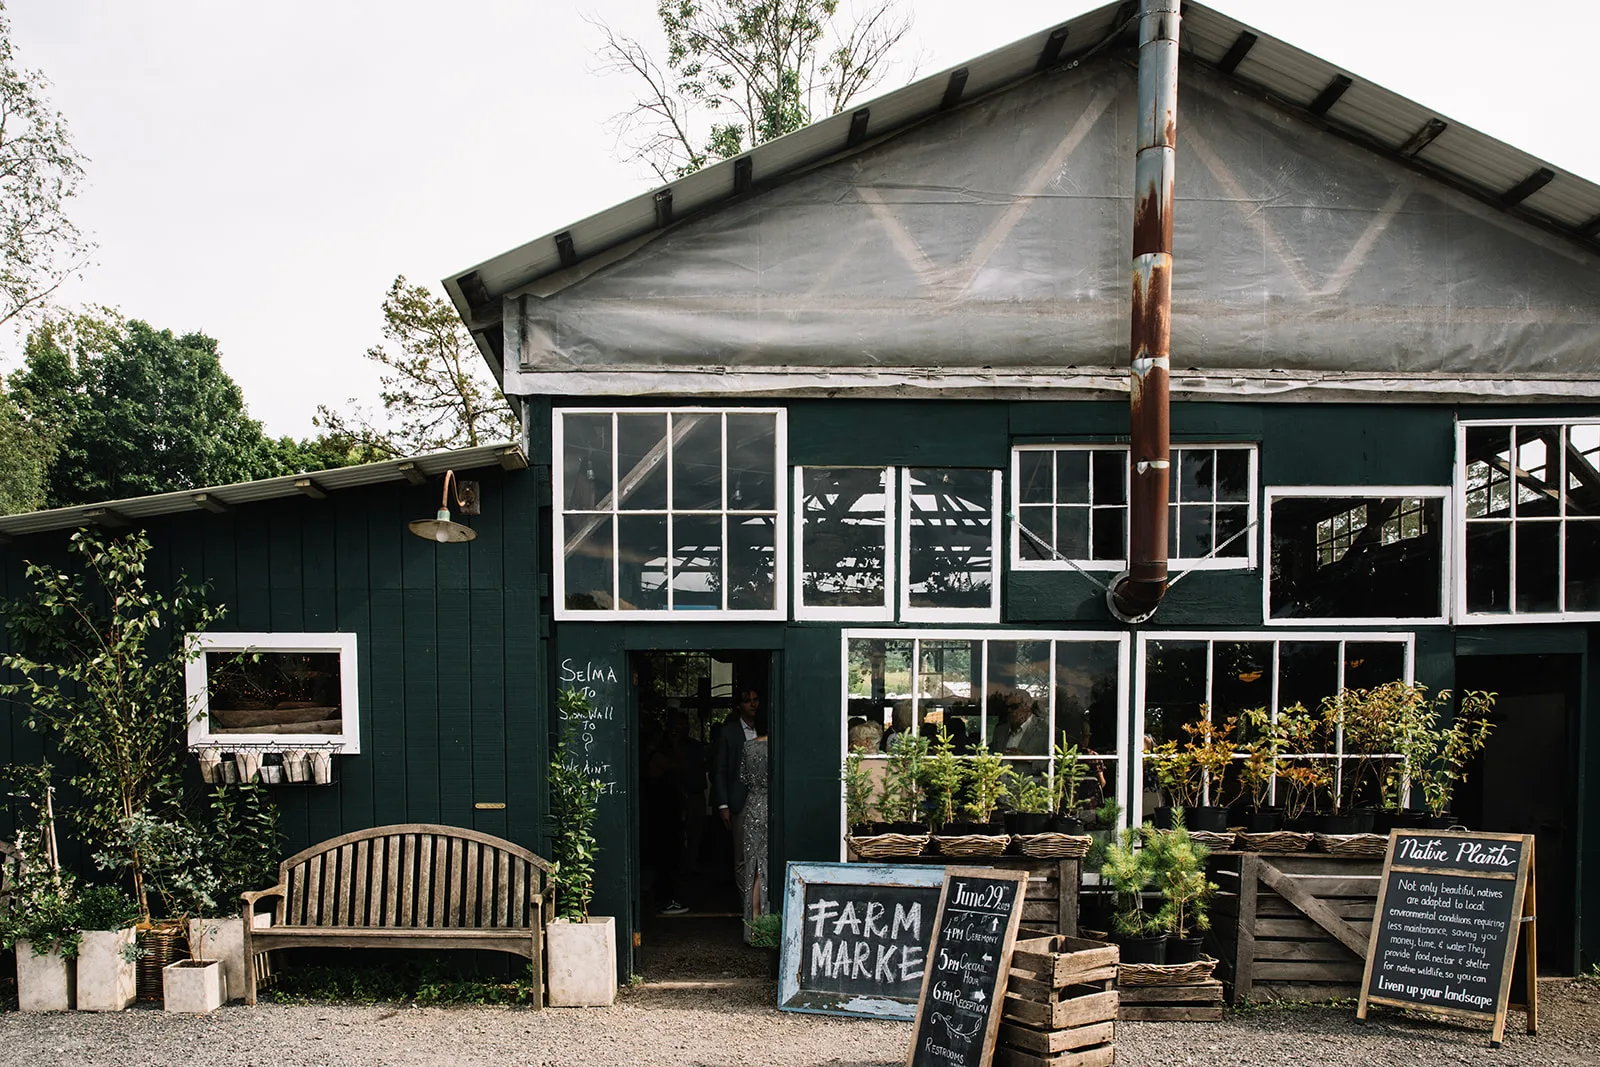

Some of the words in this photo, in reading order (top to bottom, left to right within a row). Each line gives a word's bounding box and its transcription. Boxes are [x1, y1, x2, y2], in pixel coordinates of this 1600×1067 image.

[582, 720, 596, 730] TO
[582, 732, 593, 757] ?
[1400, 839, 1449, 862] Native
[1455, 842, 1516, 866] Plants
[952, 882, 984, 907] June
[1398, 879, 1416, 891] Not
[1420, 882, 1438, 897] only
[1477, 887, 1503, 899] natives
[1406, 896, 1419, 905] are
[1421, 896, 1451, 909] adapted
[1455, 899, 1464, 909] to
[1465, 900, 1485, 911] local
[808, 899, 922, 941] FARM
[1389, 908, 1437, 921] environmental
[1473, 918, 1505, 932] requiring
[1387, 921, 1402, 931] less
[1403, 923, 1448, 937] maintenance,
[1451, 928, 1478, 942] saving
[1480, 933, 1498, 943] you
[811, 940, 926, 983] MARKE
[1384, 948, 1410, 960] provide
[1432, 955, 1455, 965] nectar
[1465, 959, 1491, 970] shelter
[1467, 943, 1487, 959] They
[1383, 961, 1394, 970] for
[1396, 964, 1416, 974] native
[1445, 971, 1454, 979] so
[1457, 973, 1471, 984] you
[1472, 975, 1487, 983] can
[1378, 975, 1405, 993] Liven
[1406, 986, 1418, 998] up
[1420, 987, 1443, 1000] your
[1444, 985, 1492, 1009] landscape
